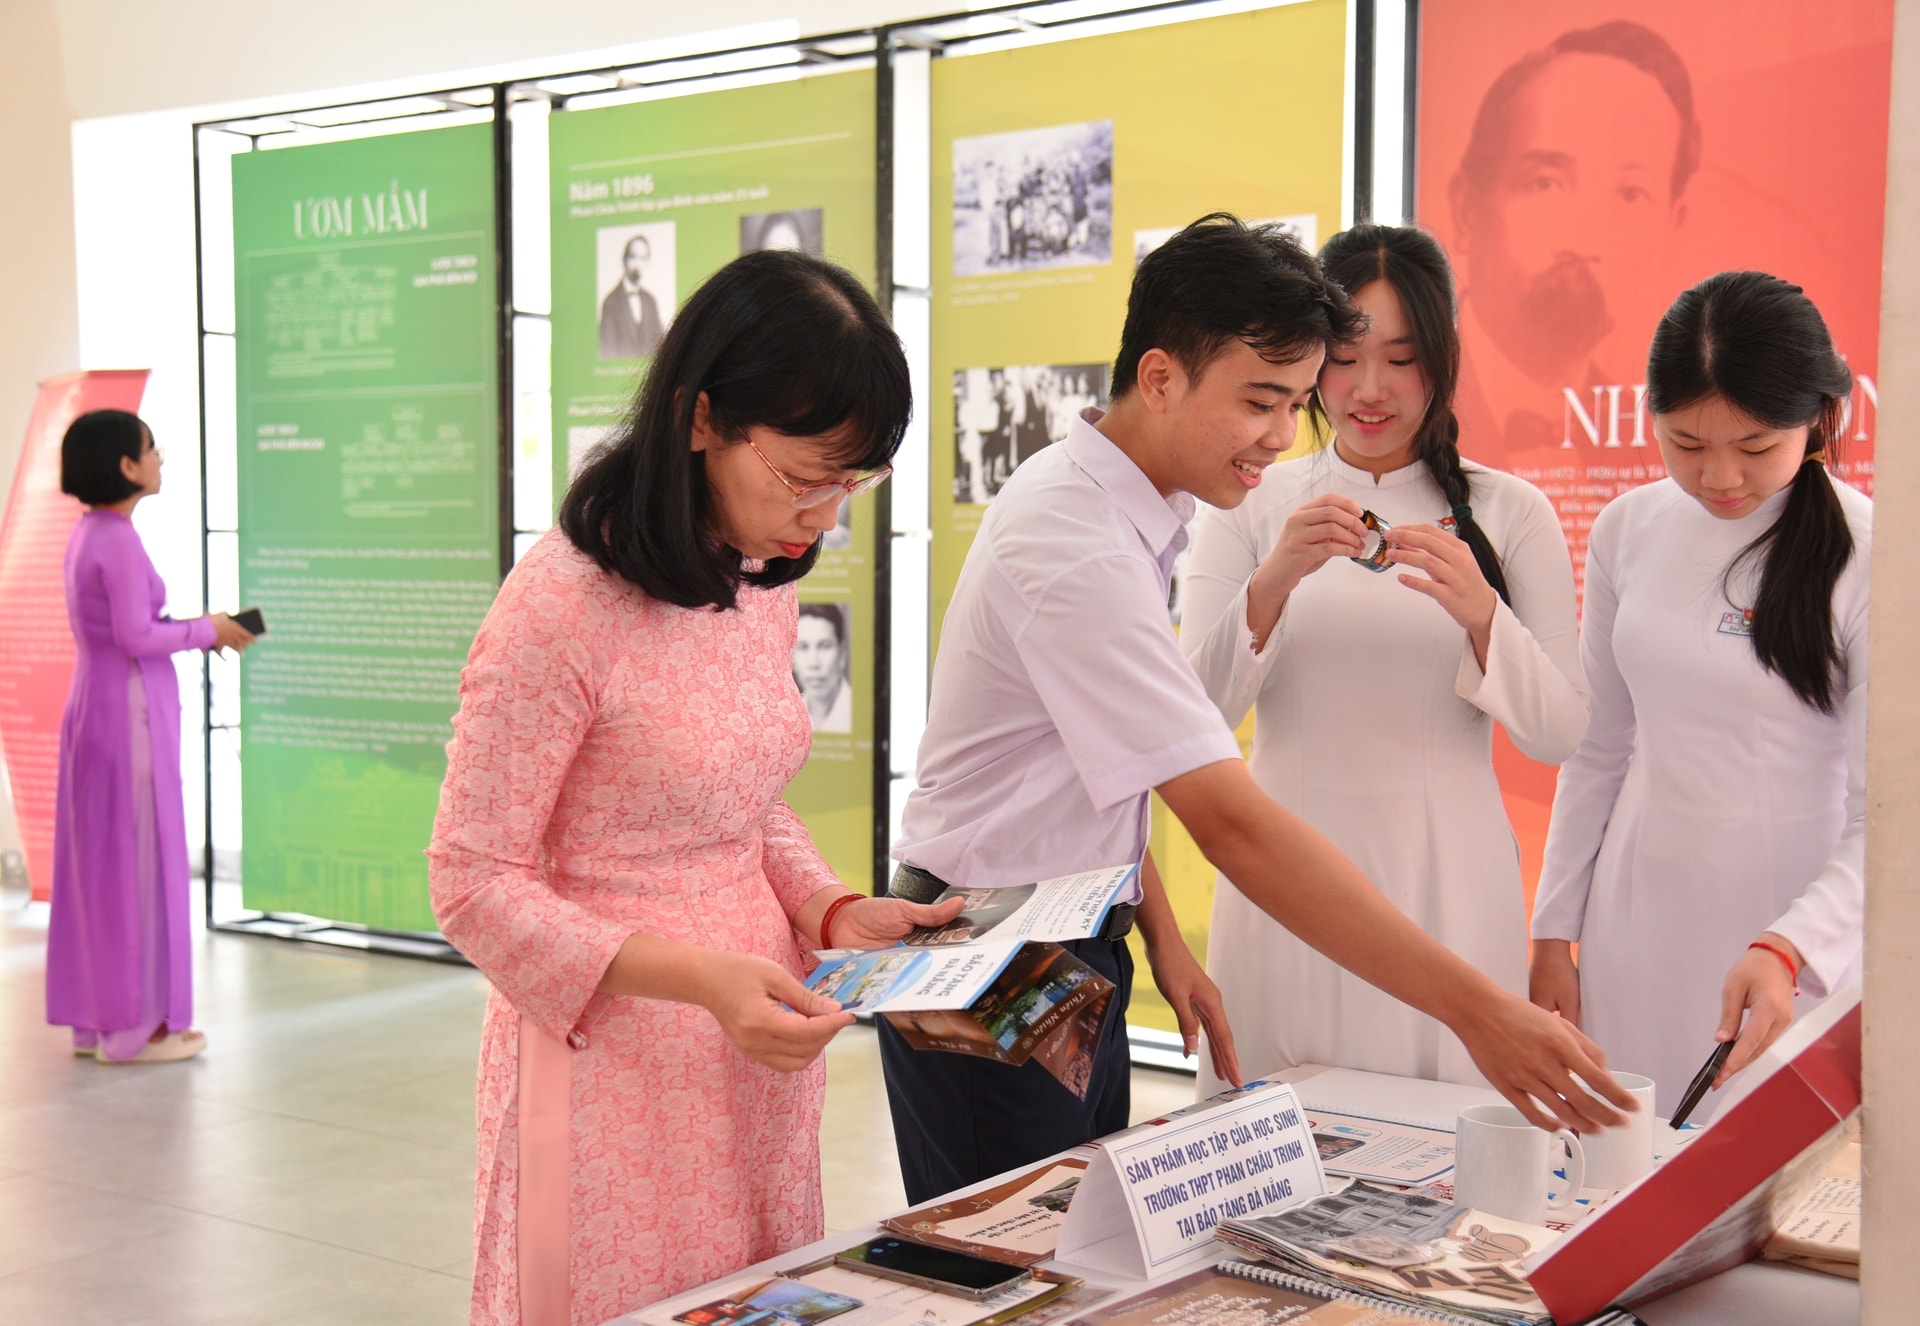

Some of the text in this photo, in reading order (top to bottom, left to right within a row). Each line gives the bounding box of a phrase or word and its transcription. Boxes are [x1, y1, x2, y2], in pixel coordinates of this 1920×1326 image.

[612, 173, 655, 198] 1896
[1126, 1108, 1299, 1185] SẢN PHẨM HỌC TẬP CỦA HỌC SINH
[1143, 1140, 1305, 1215] TRƯỜNG THPT PHAN CHÂU TRINH
[1176, 1177, 1293, 1241] TẠI BẢO TÀNG ĐÀ NẴNG
